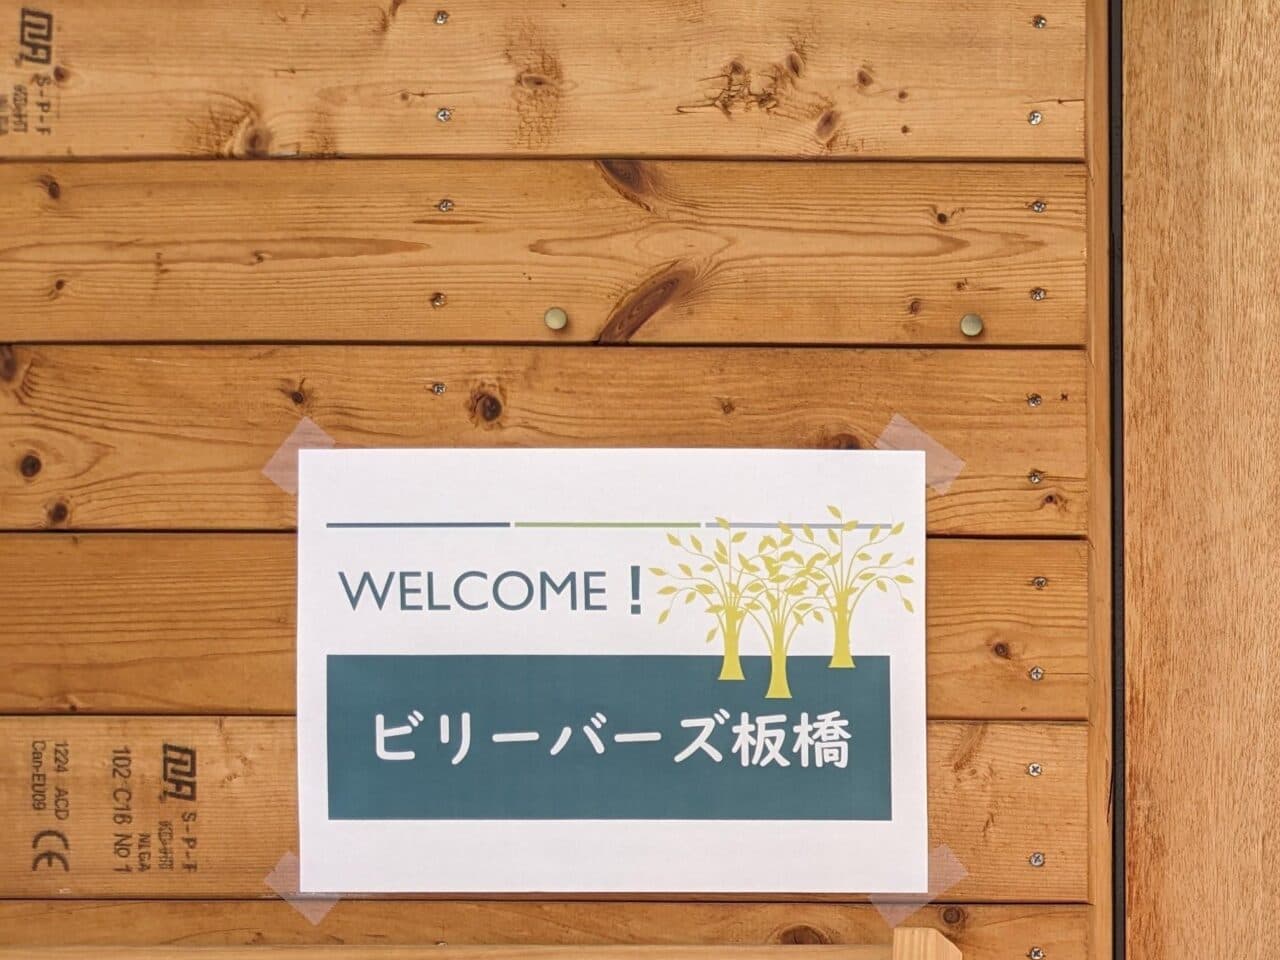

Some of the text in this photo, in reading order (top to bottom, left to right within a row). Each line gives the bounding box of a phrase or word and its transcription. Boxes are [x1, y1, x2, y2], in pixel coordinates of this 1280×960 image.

[112, 745, 132, 779] 102
[374, 709, 854, 770] ビリーバーズ板橋
[54, 741, 70, 821] 1224 ACD
